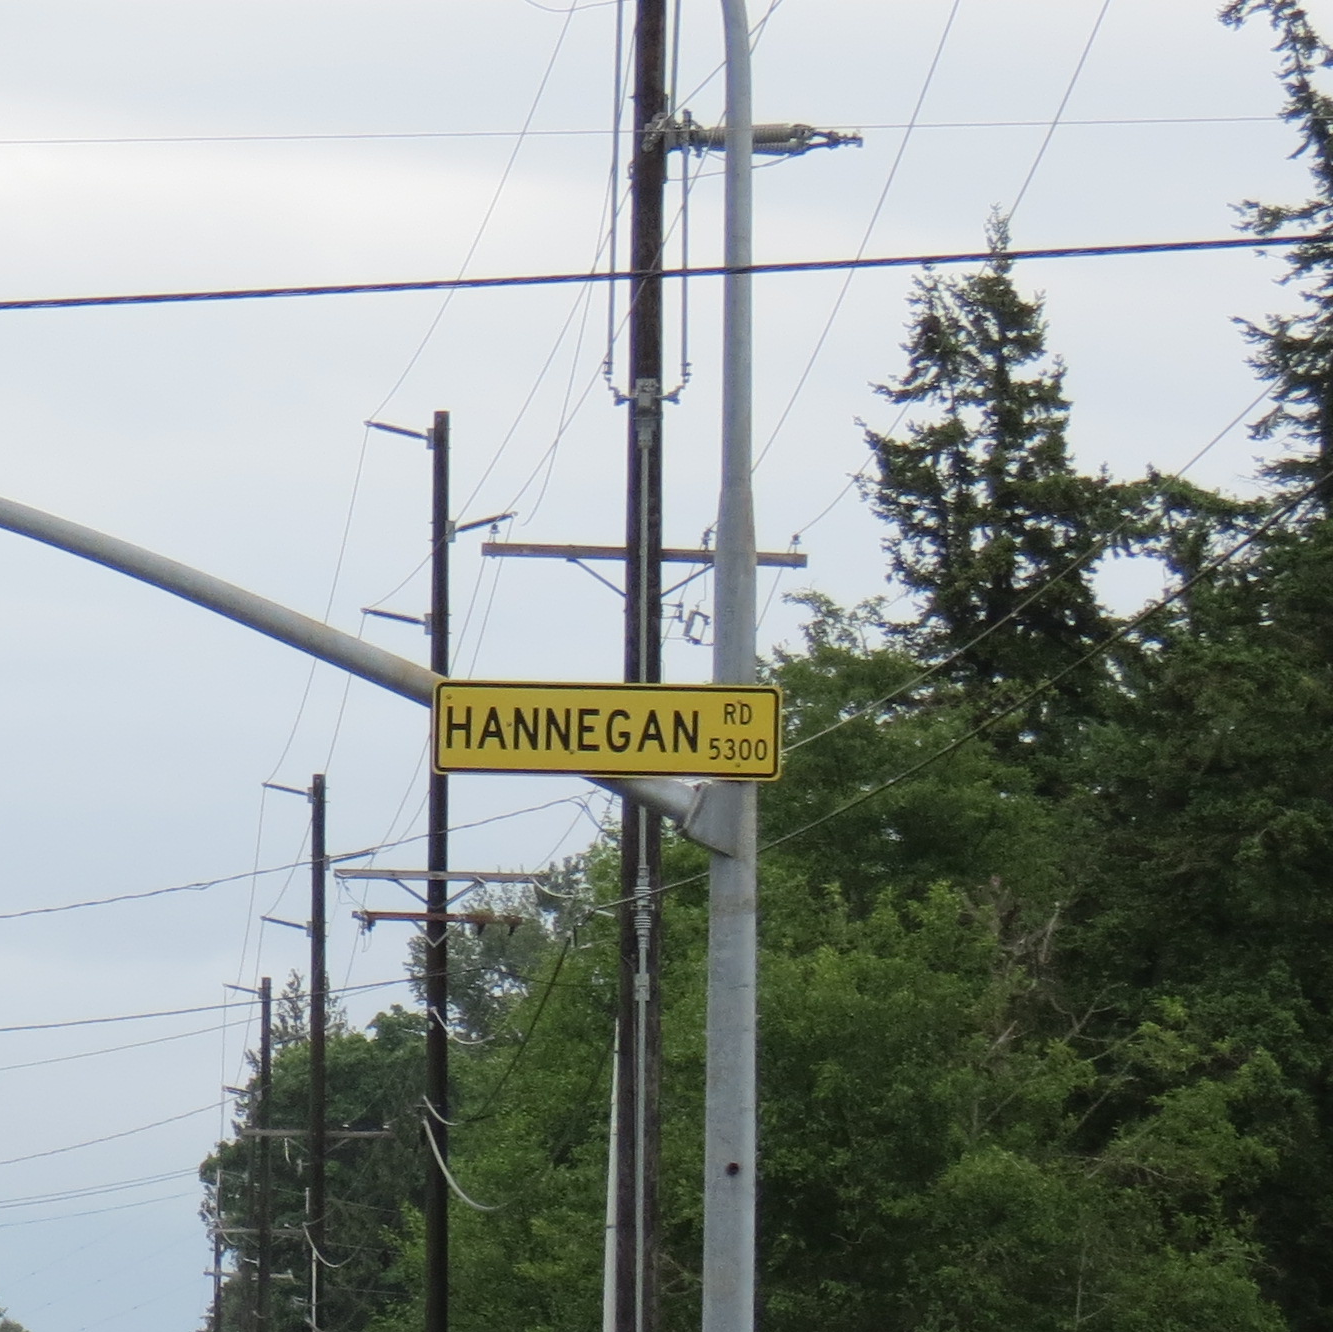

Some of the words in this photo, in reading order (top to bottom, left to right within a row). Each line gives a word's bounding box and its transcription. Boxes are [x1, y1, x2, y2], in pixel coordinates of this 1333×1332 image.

[445, 704, 700, 754] HANNEGAN
[723, 702, 753, 726] RD
[708, 737, 768, 762] 5300
